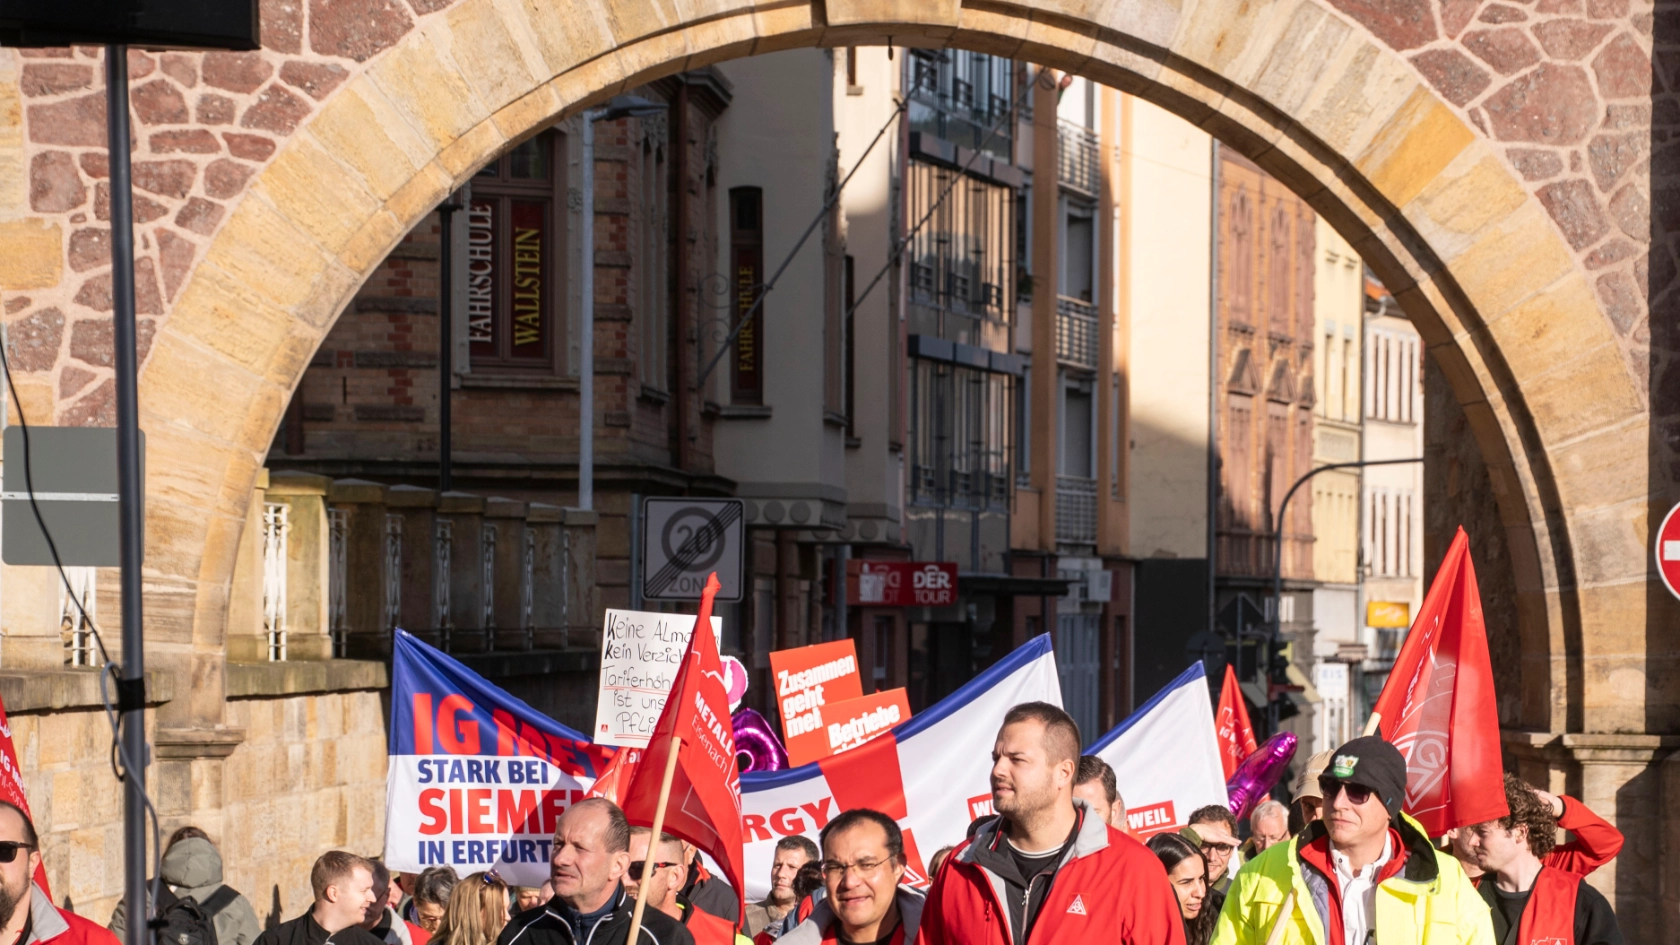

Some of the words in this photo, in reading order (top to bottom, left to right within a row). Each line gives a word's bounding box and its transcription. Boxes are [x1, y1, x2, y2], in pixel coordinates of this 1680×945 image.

[469, 204, 492, 342] FAHRSCHULE
[514, 227, 541, 346] WALLSTEIN
[677, 525, 711, 555] 20
[668, 577, 704, 593] ZON
[914, 590, 951, 603] TOUR
[607, 612, 646, 641] Keine
[602, 664, 671, 690] Tariferhöh
[777, 654, 856, 698] Zusammen
[641, 697, 666, 711] uns
[782, 684, 826, 720] geht
[413, 692, 481, 755] IG
[695, 691, 733, 757] METALL
[785, 707, 824, 739] meh
[827, 704, 900, 749] Betriebe
[691, 713, 728, 774] Eisenach
[417, 758, 501, 784] STARK
[507, 761, 549, 785] BEI
[417, 787, 582, 836] SIEME
[742, 796, 832, 843] RGY
[1127, 807, 1171, 829] WEIL
[418, 840, 445, 865] IN
[452, 840, 553, 865] ERFURT
